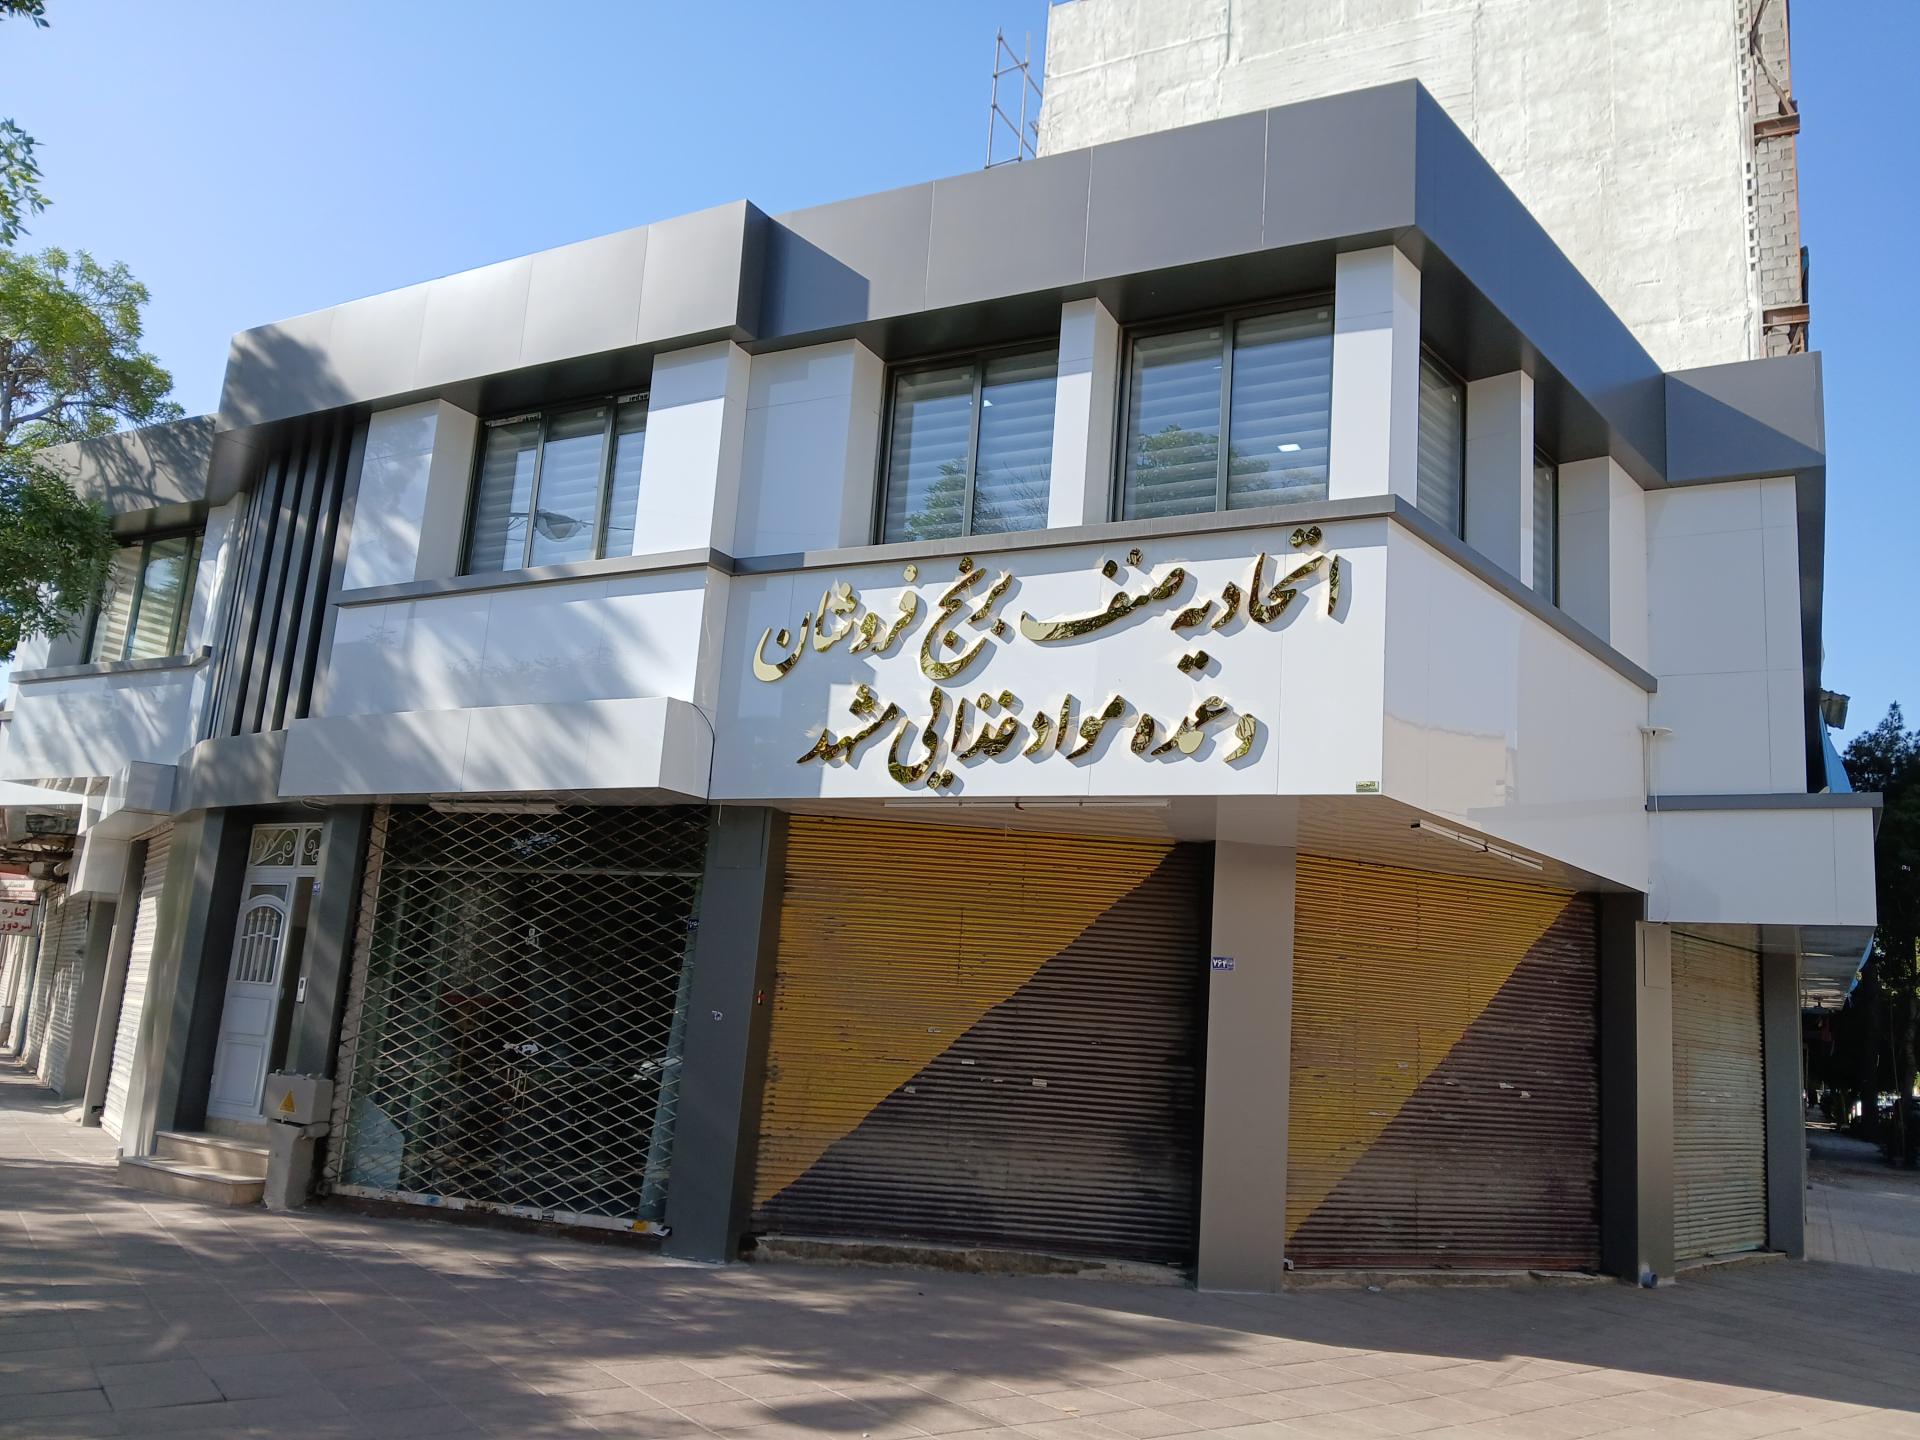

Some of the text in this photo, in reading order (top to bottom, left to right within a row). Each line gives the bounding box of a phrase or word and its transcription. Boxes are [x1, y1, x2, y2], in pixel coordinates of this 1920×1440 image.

[752, 526, 1339, 682] اتحادیه صنف برنج فروشان
[796, 684, 898, 761] مشهد
[1022, 693, 1126, 759] مواد
